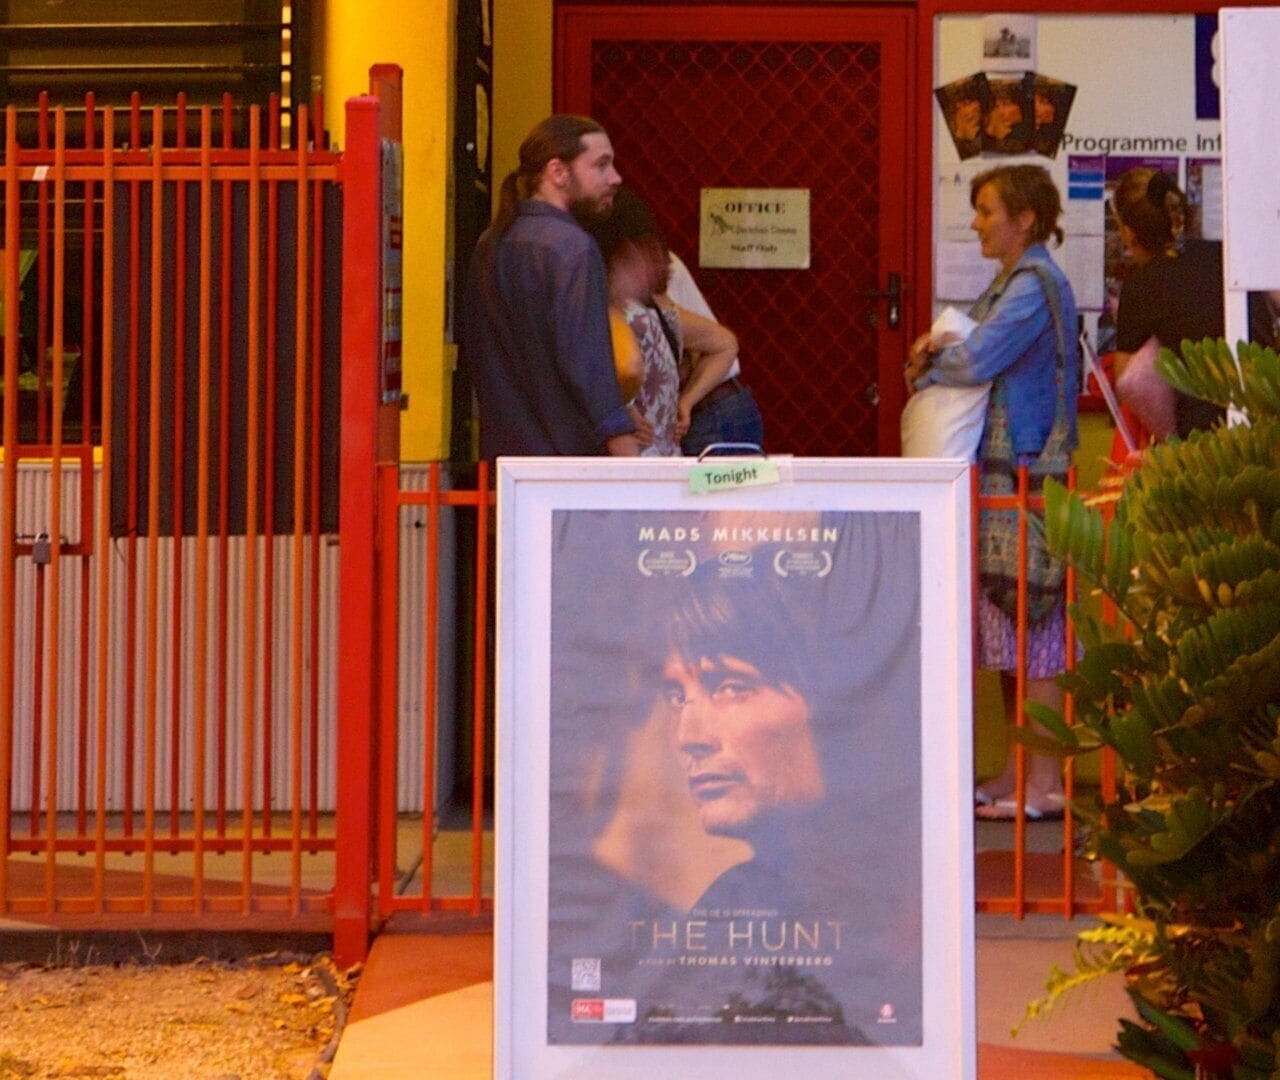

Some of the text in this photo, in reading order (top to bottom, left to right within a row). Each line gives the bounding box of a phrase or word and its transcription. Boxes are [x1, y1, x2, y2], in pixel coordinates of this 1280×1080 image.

[1061, 133, 1188, 155] Programme
[725, 201, 787, 215] OFFICE
[704, 467, 758, 487] Tonight
[638, 527, 839, 543] MADS MIKKELSEN
[628, 920, 846, 951] THE HUNT
[678, 956, 738, 967] THOMAS
[744, 956, 834, 967] VINTERBERG
